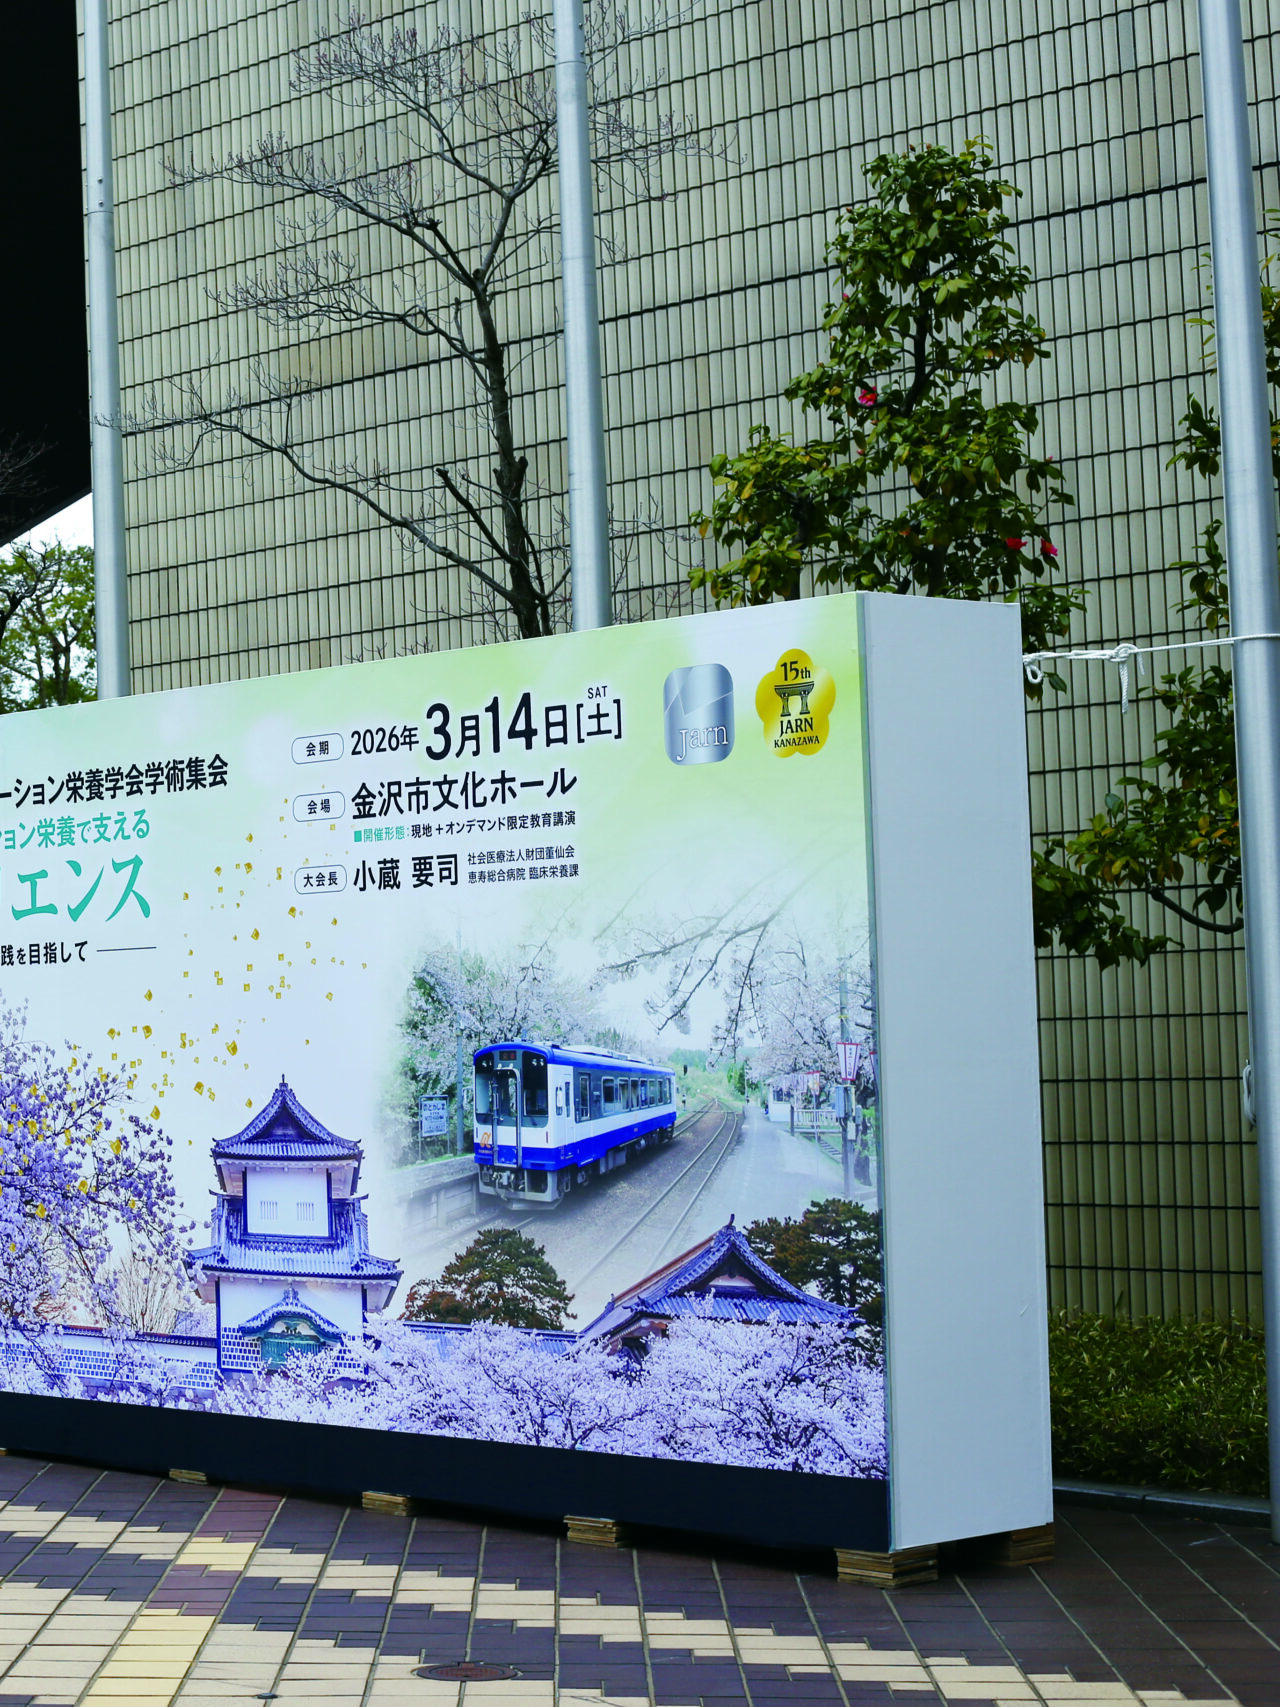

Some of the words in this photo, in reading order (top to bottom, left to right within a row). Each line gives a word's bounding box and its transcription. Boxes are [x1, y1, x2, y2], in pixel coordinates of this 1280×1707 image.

[780, 660, 811, 682] 15th
[587, 686, 608, 699] SAT
[780, 717, 814, 738] JARN
[305, 740, 330, 757] 会期
[676, 725, 729, 761] Jarn
[774, 735, 820, 749] KANAZAWA
[351, 767, 578, 820] 金沢市文化ホール
[306, 798, 331, 815] 会場
[303, 871, 339, 888] 大会長
[352, 857, 402, 893] 小蔵
[411, 853, 459, 889] 要司
[467, 866, 526, 884] 恵寿総合病院
[528, 863, 580, 881] 臨床栄養課
